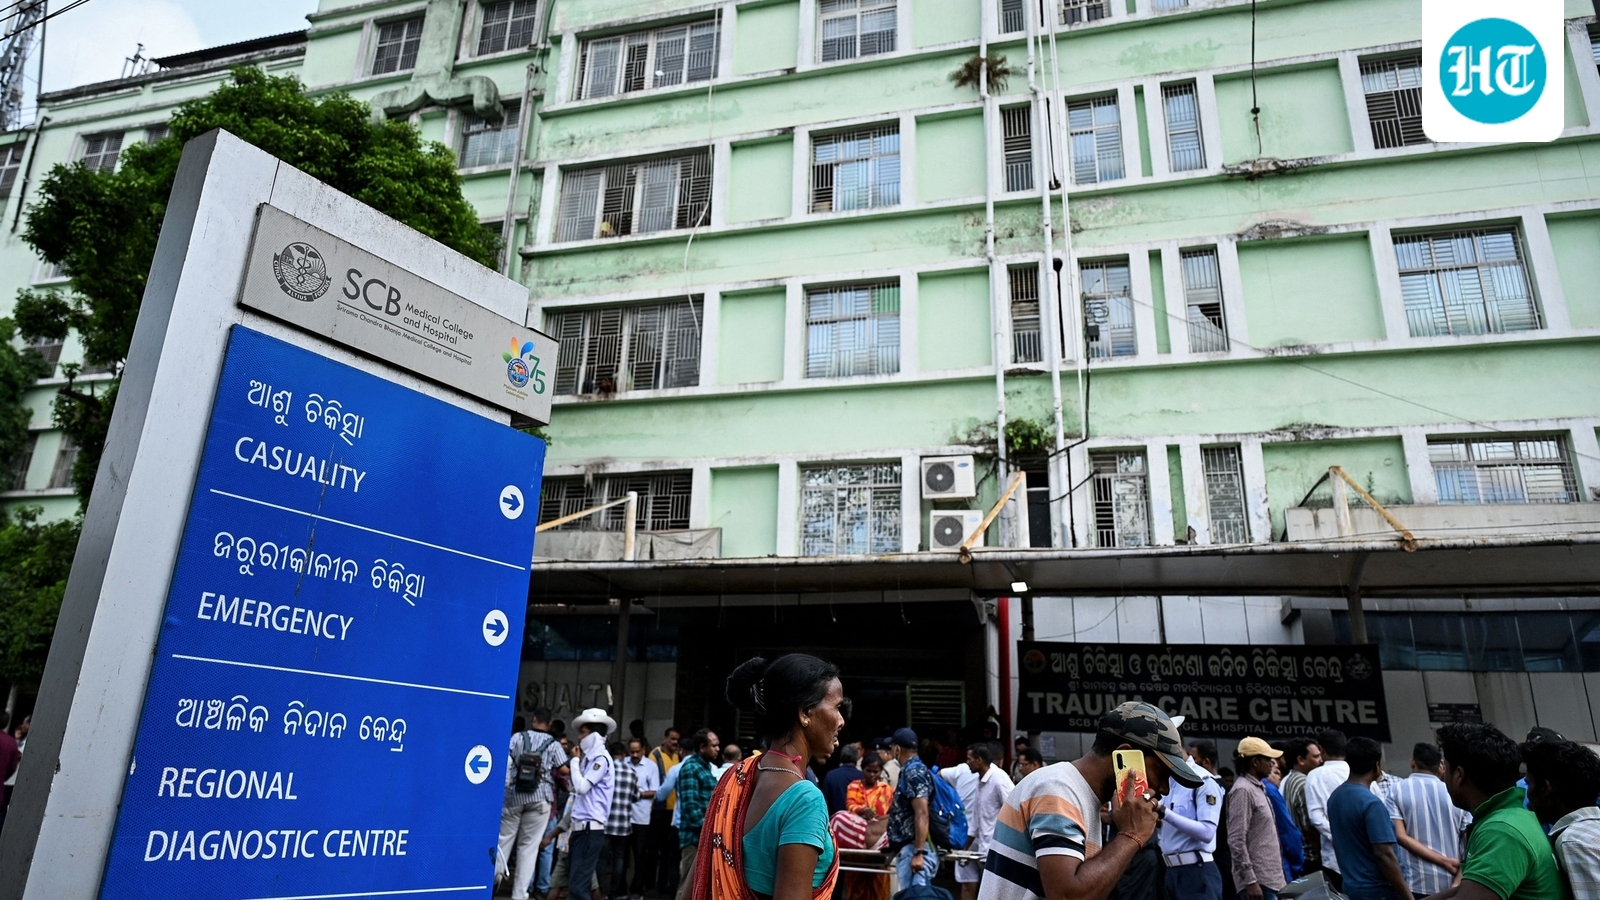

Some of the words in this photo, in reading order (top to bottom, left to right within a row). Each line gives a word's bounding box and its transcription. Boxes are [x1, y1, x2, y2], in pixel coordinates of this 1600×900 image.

[287, 289, 308, 301] ALTIUS
[314, 280, 331, 298] FORTIUS
[342, 268, 401, 316] SCB
[336, 304, 359, 318] Srirama
[360, 313, 383, 328] Chandra
[383, 323, 402, 337] Bhanja
[402, 333, 423, 346] Medical
[423, 341, 442, 355] College
[442, 349, 452, 359] and
[452, 352, 472, 367] Hospital
[403, 315, 420, 329] and
[423, 322, 458, 346] Hospital
[405, 302, 440, 325] Medical
[442, 318, 474, 341] College
[529, 354, 546, 395] 75
[247, 379, 292, 427] ଆଶୁ
[234, 436, 367, 493] CASUALITY
[213, 531, 359, 584] ଜରୁରୀକାଳୀନ
[197, 591, 354, 641] EMERGENCY
[1050, 652, 1081, 680] ଆଶୁ
[1207, 647, 1249, 678] ଜନିତ
[516, 681, 614, 713] SUALT
[1157, 695, 1239, 721] CARE
[1248, 697, 1379, 725] CENTRE
[175, 694, 269, 733] ଆଞ୍ଚଳିକ
[283, 700, 347, 739] ନିଦାନ
[359, 715, 408, 752] କେନ୍ଦ୍ର
[1068, 717, 1092, 728] SCB
[1201, 724, 1209, 732] &
[1212, 723, 1274, 735] HOSPITAL,
[158, 767, 298, 800] REGIONAL
[143, 830, 319, 862] DIAGNOSTIC
[322, 829, 409, 858] CENTRE
